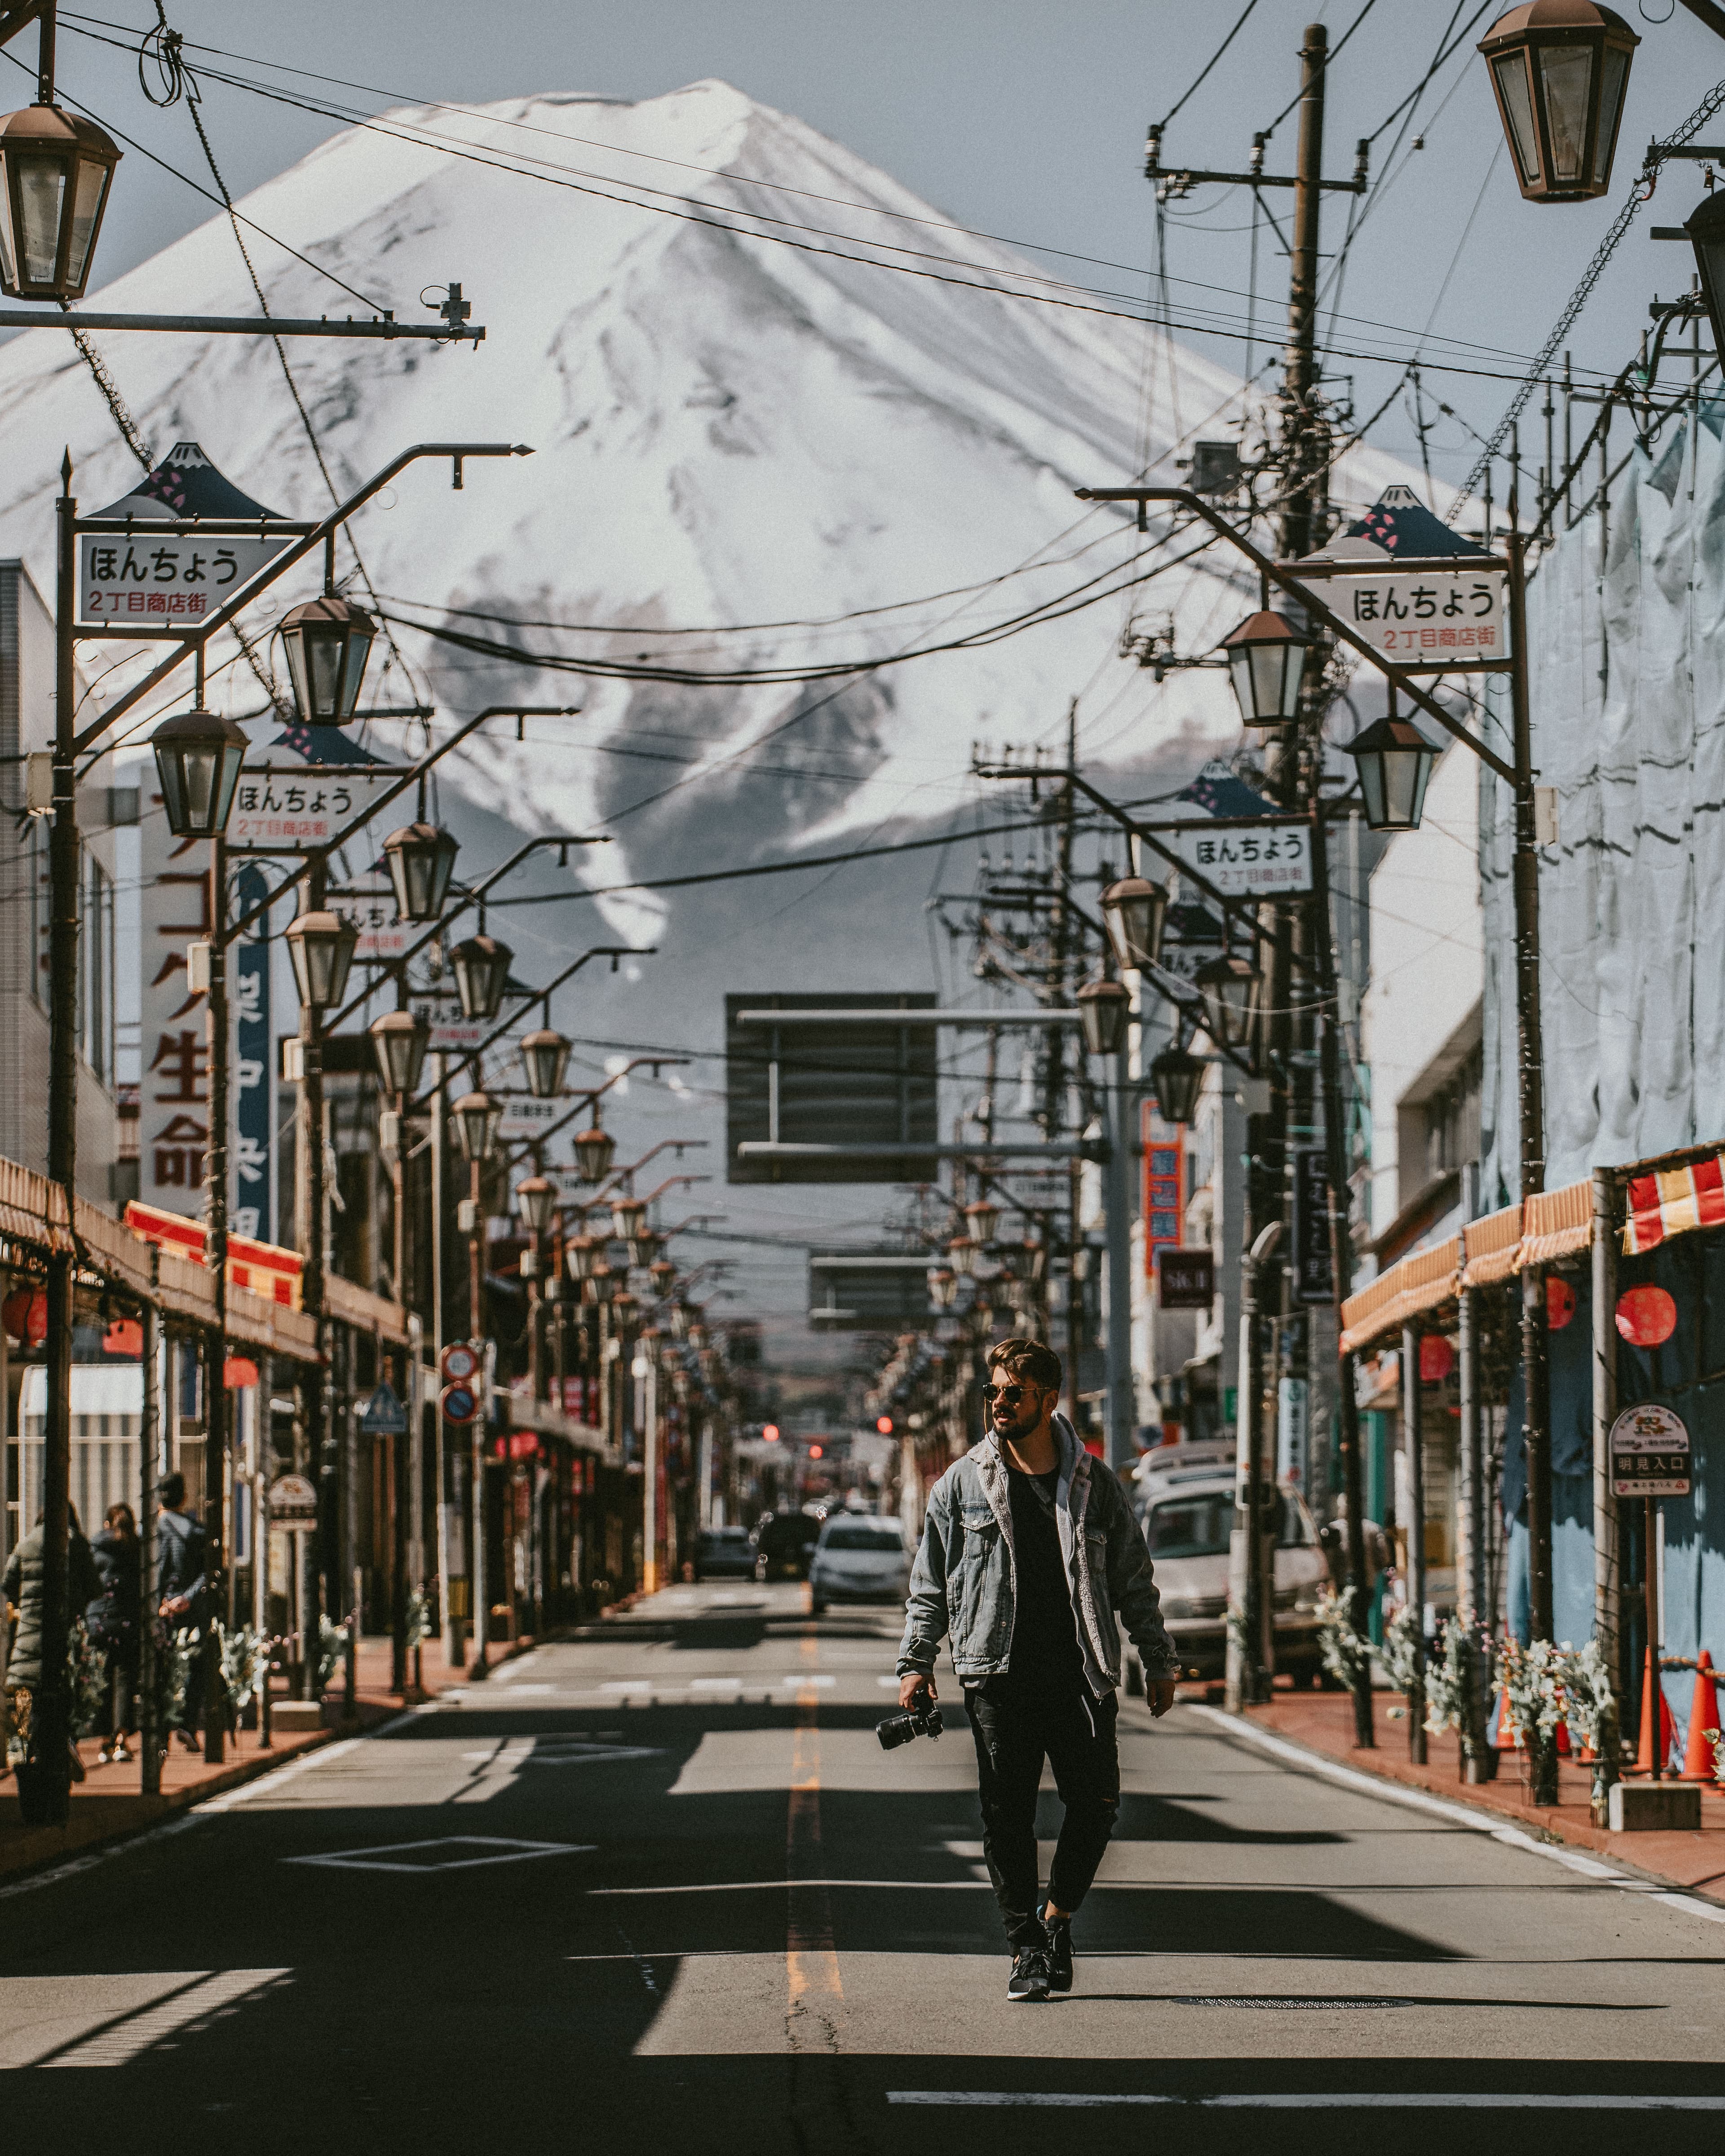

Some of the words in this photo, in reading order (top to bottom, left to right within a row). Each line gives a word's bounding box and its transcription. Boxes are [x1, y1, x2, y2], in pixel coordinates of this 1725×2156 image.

[90, 546, 238, 585] ほんちょう
[88, 591, 207, 614] 2丁目商店街
[1353, 583, 1493, 621] ほんちょう
[1384, 626, 1495, 650] 2丁目商店街
[238, 785, 352, 814] ほんちょう
[1196, 834, 1304, 864] ほんちょう
[1619, 1457, 1684, 1471] 明見入口
